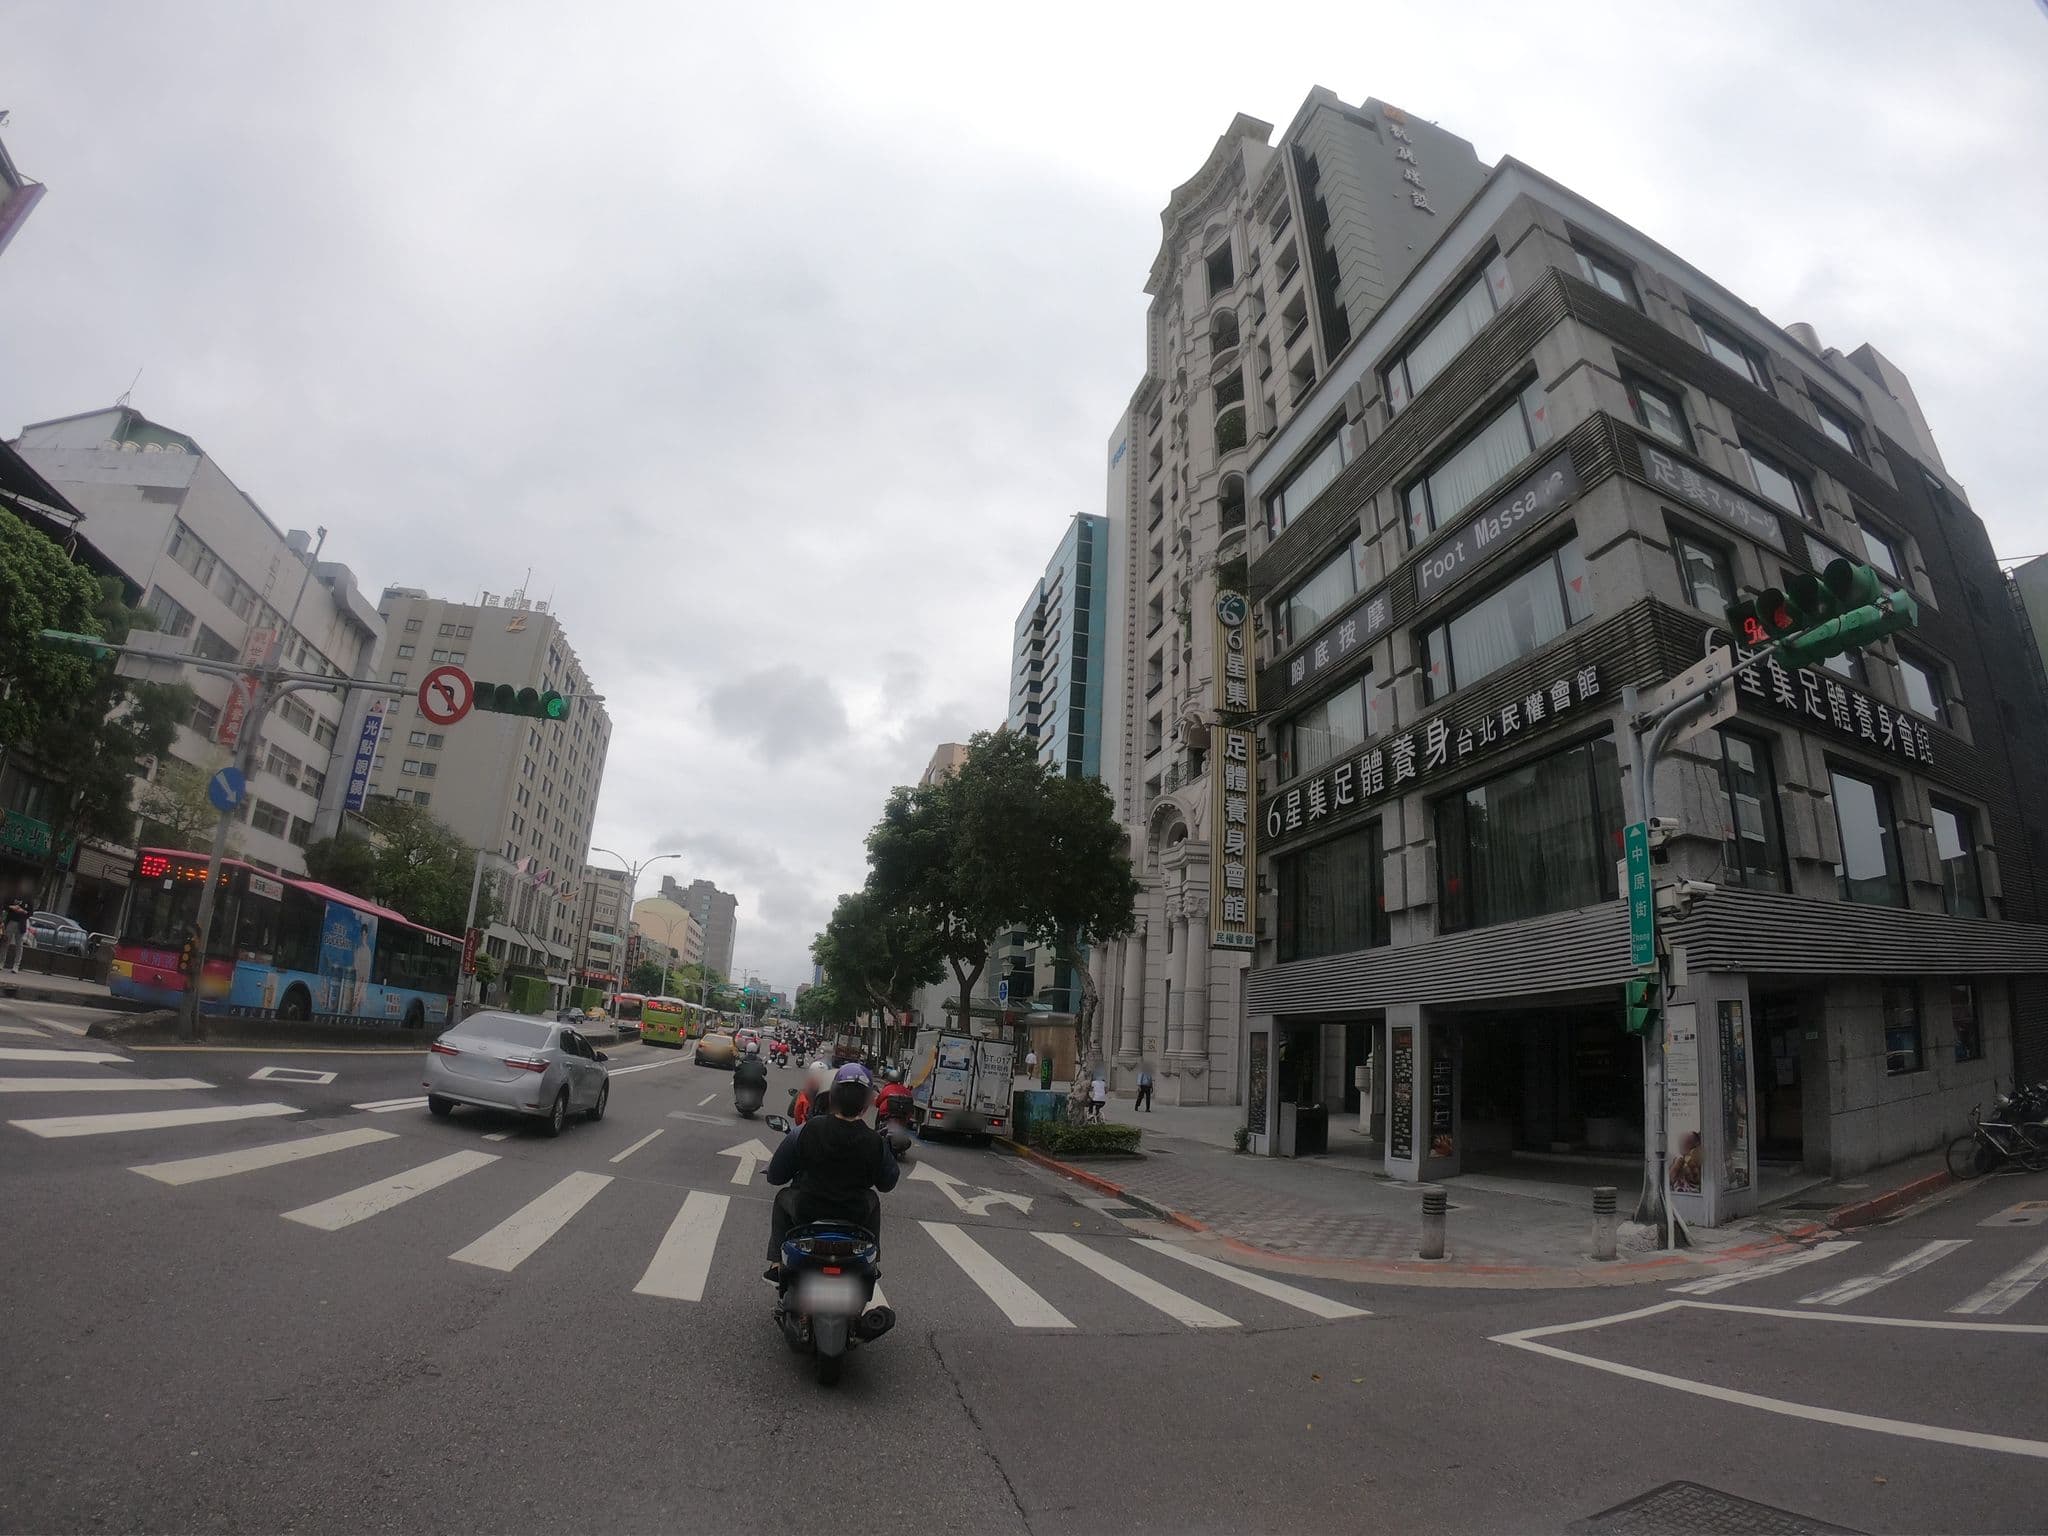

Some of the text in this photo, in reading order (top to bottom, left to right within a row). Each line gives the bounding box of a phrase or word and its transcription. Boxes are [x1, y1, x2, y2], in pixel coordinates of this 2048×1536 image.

[1422, 541, 1465, 588] Foot
[1291, 598, 1385, 686] 腳底按摩
[1631, 845, 1647, 919] 中原街
